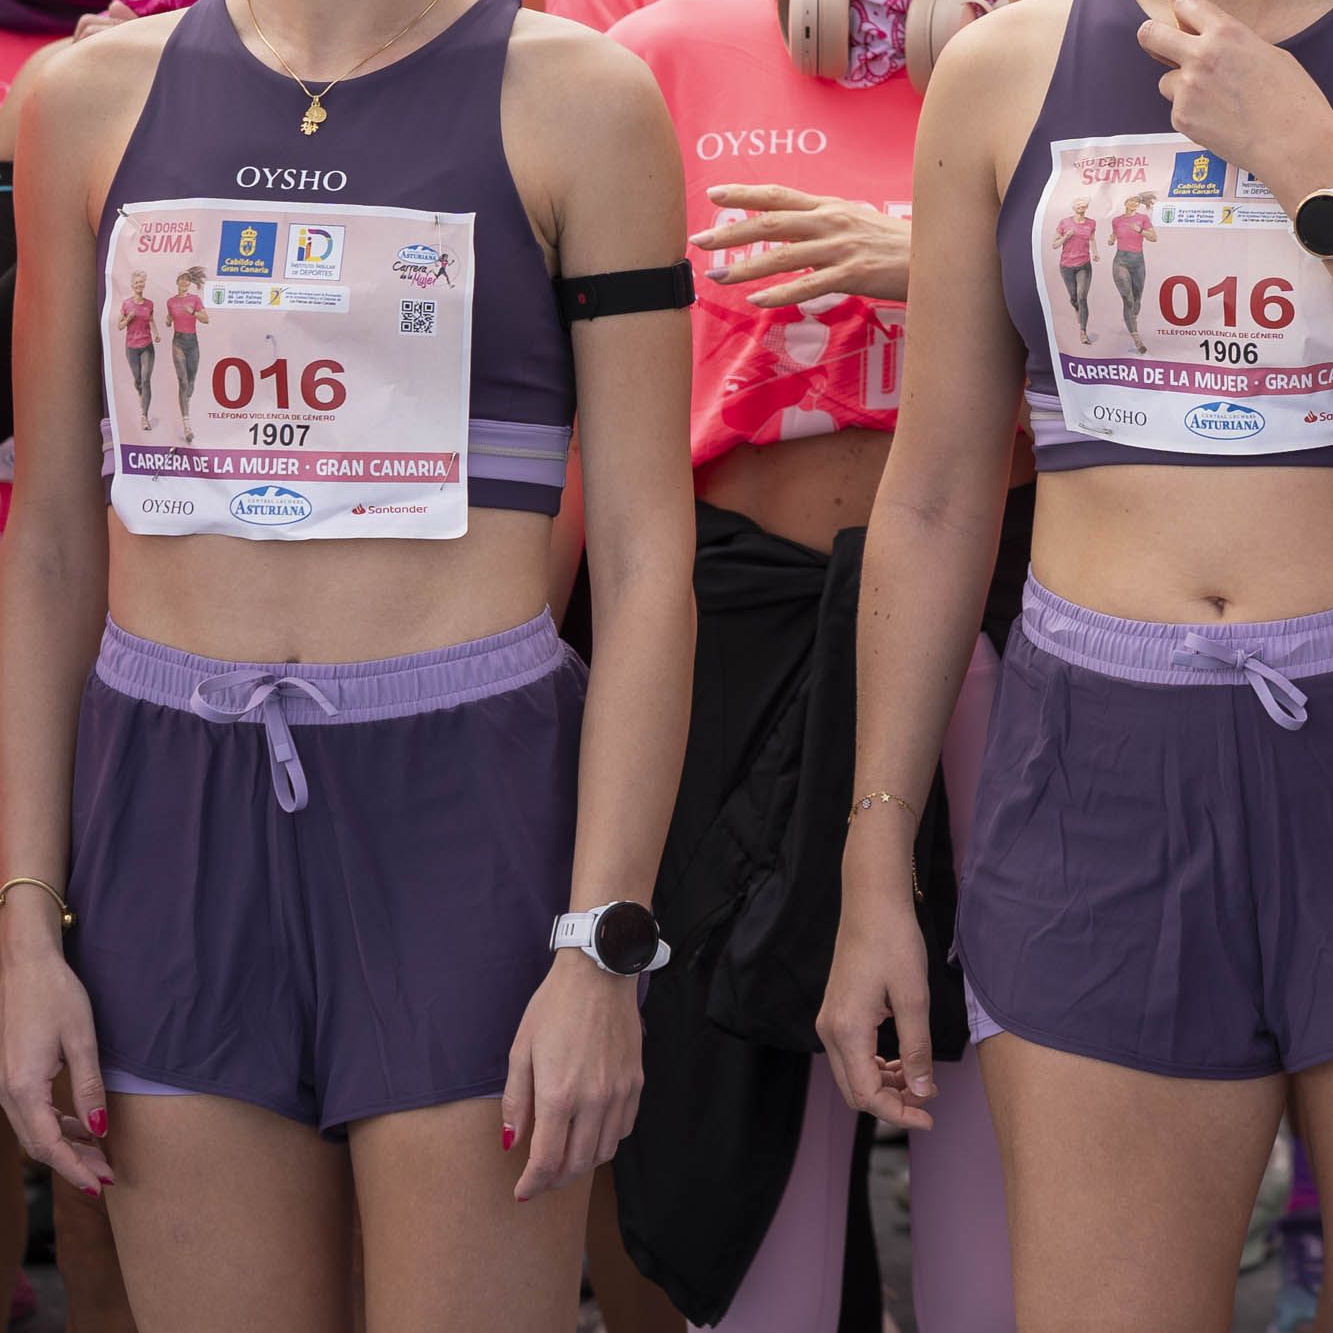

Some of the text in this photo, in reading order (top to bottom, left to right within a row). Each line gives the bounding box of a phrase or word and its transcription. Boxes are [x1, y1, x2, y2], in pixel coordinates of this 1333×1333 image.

[696, 128, 827, 161] OYSHO
[1099, 156, 1149, 168] DORSAL
[236, 166, 348, 192] OYSHO
[1082, 168, 1147, 186] SUMA
[140, 221, 196, 233] TU DORSAL
[137, 233, 194, 254] SUMA
[221, 265, 270, 274] Gran Canaria
[225, 258, 254, 266] Cabildo
[392, 261, 428, 274] Carrera
[299, 269, 333, 277] DEPORTES
[1159, 275, 1296, 330] 016
[1157, 329, 1284, 340] TELÉFONO VIOLENCIA DE GÉNERO
[1199, 340, 1259, 365] 1906
[211, 357, 348, 411] 016
[1068, 361, 1139, 384] CARRERA
[1143, 367, 1165, 385] DE
[1170, 369, 1190, 387] LA
[1195, 372, 1249, 392] MUJER
[1265, 372, 1313, 390] GRAN
[207, 412, 248, 420] TELÉFONO
[249, 413, 291, 421] VIOLENCIA
[302, 413, 336, 422] GÉNERO
[1093, 405, 1148, 427] OYSHO
[1190, 415, 1260, 431] ASTURIANA
[248, 423, 311, 447] 1907
[128, 452, 448, 477] CARRERA DE LA MUJER GRAN CANARIA
[142, 498, 195, 516] OYSHO
[234, 501, 306, 517] ASTURIANA
[368, 505, 428, 515] Santander
